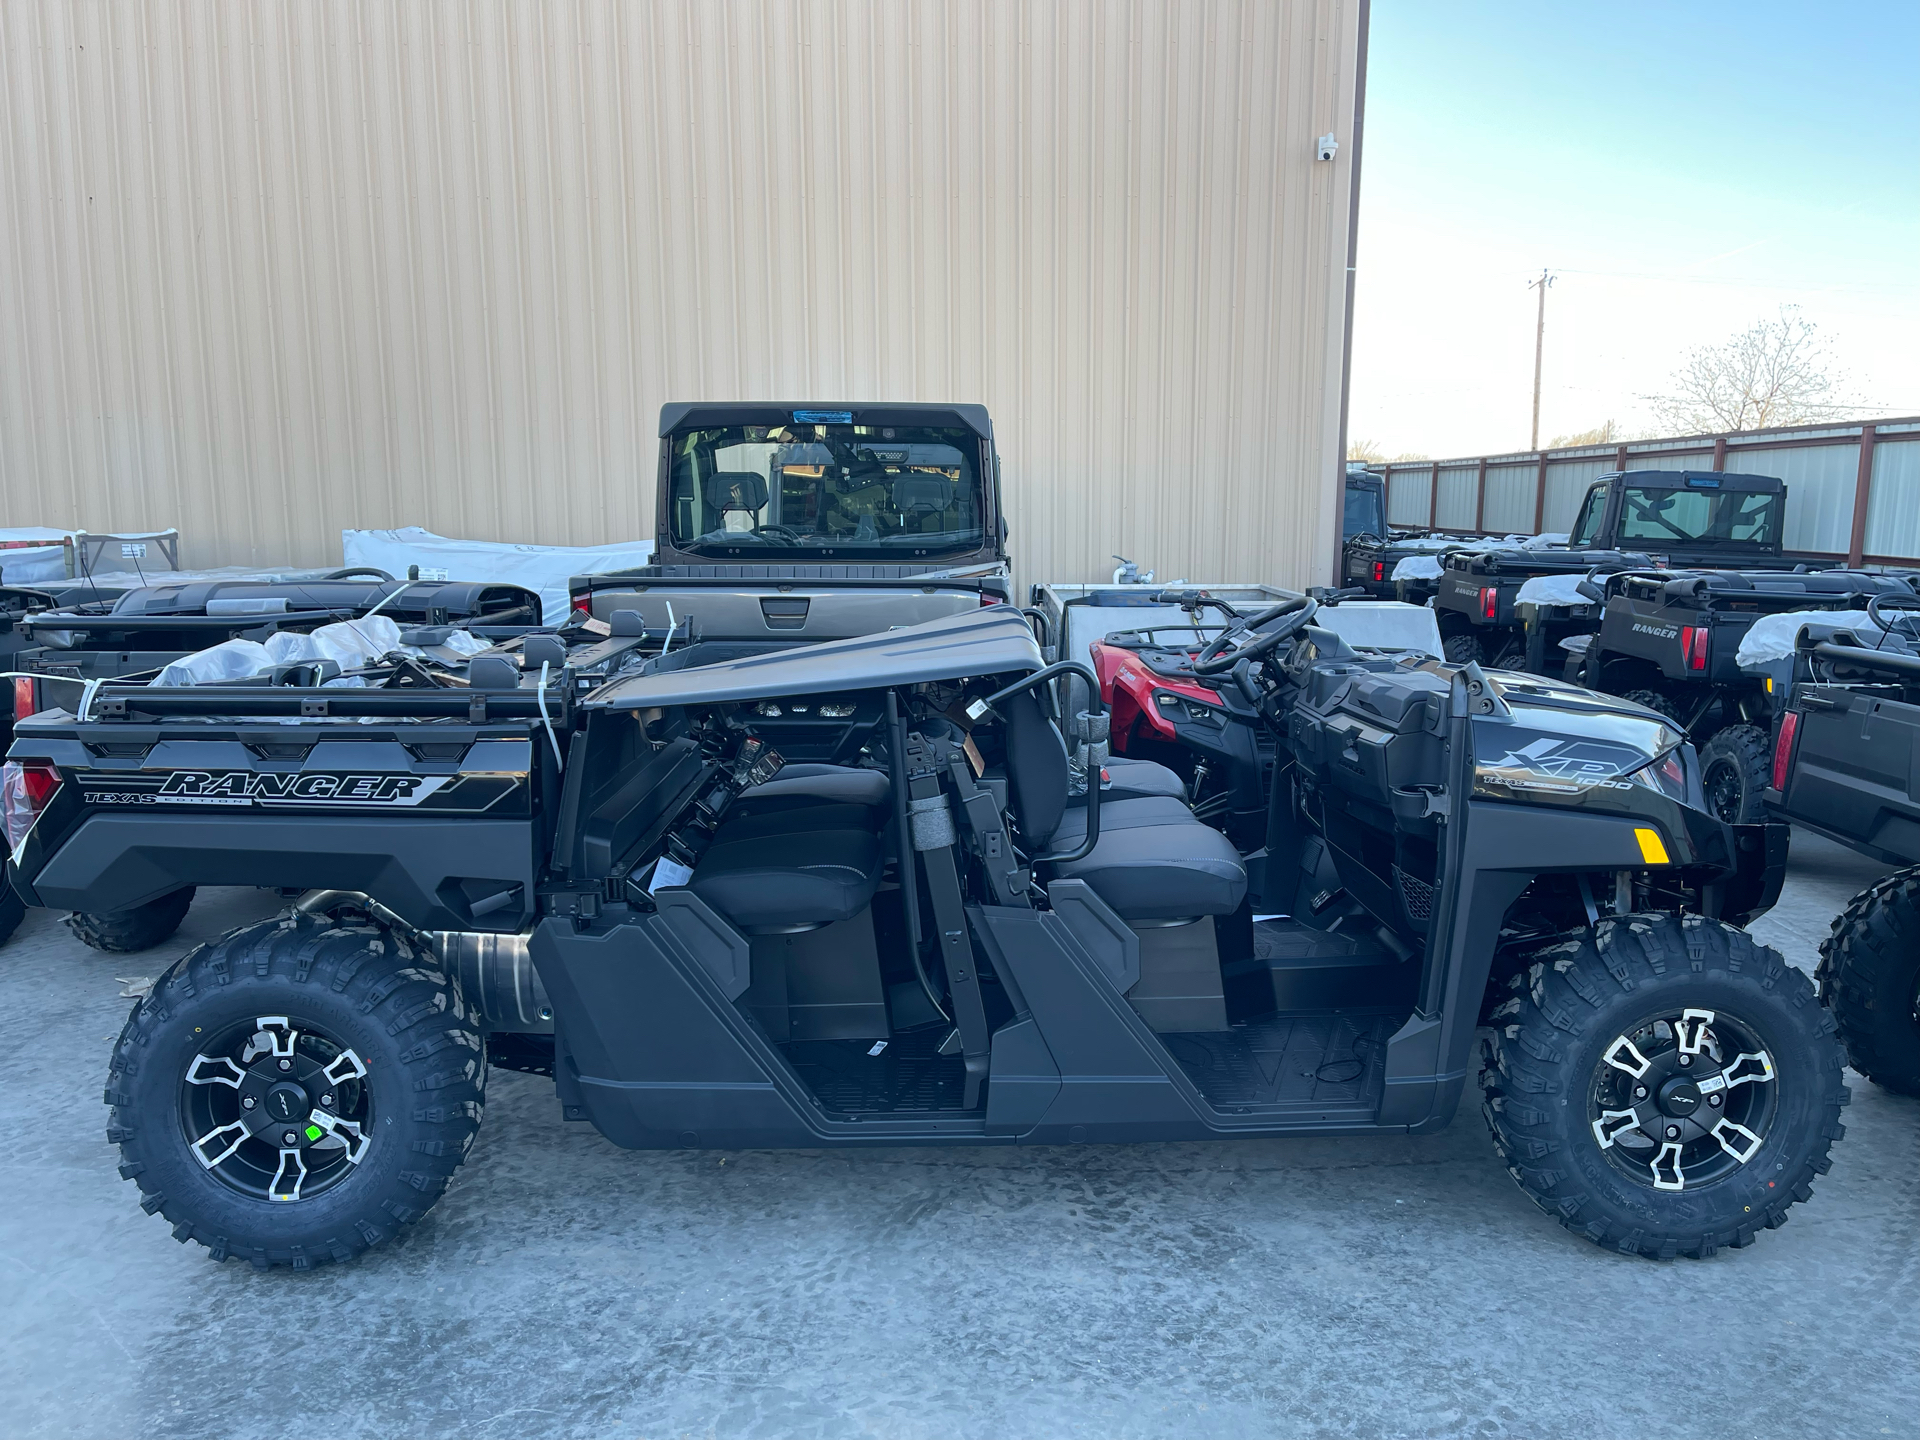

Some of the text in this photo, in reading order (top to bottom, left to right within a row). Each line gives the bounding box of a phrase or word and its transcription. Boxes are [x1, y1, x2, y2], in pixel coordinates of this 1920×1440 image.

[1454, 587, 1479, 597] RANGER
[1631, 623, 1678, 640] RANGER
[160, 772, 423, 798] RANGER
[1483, 776, 1526, 787] TEXAS
[1574, 776, 1634, 791] 1000
[83, 792, 158, 805] TEXAS
